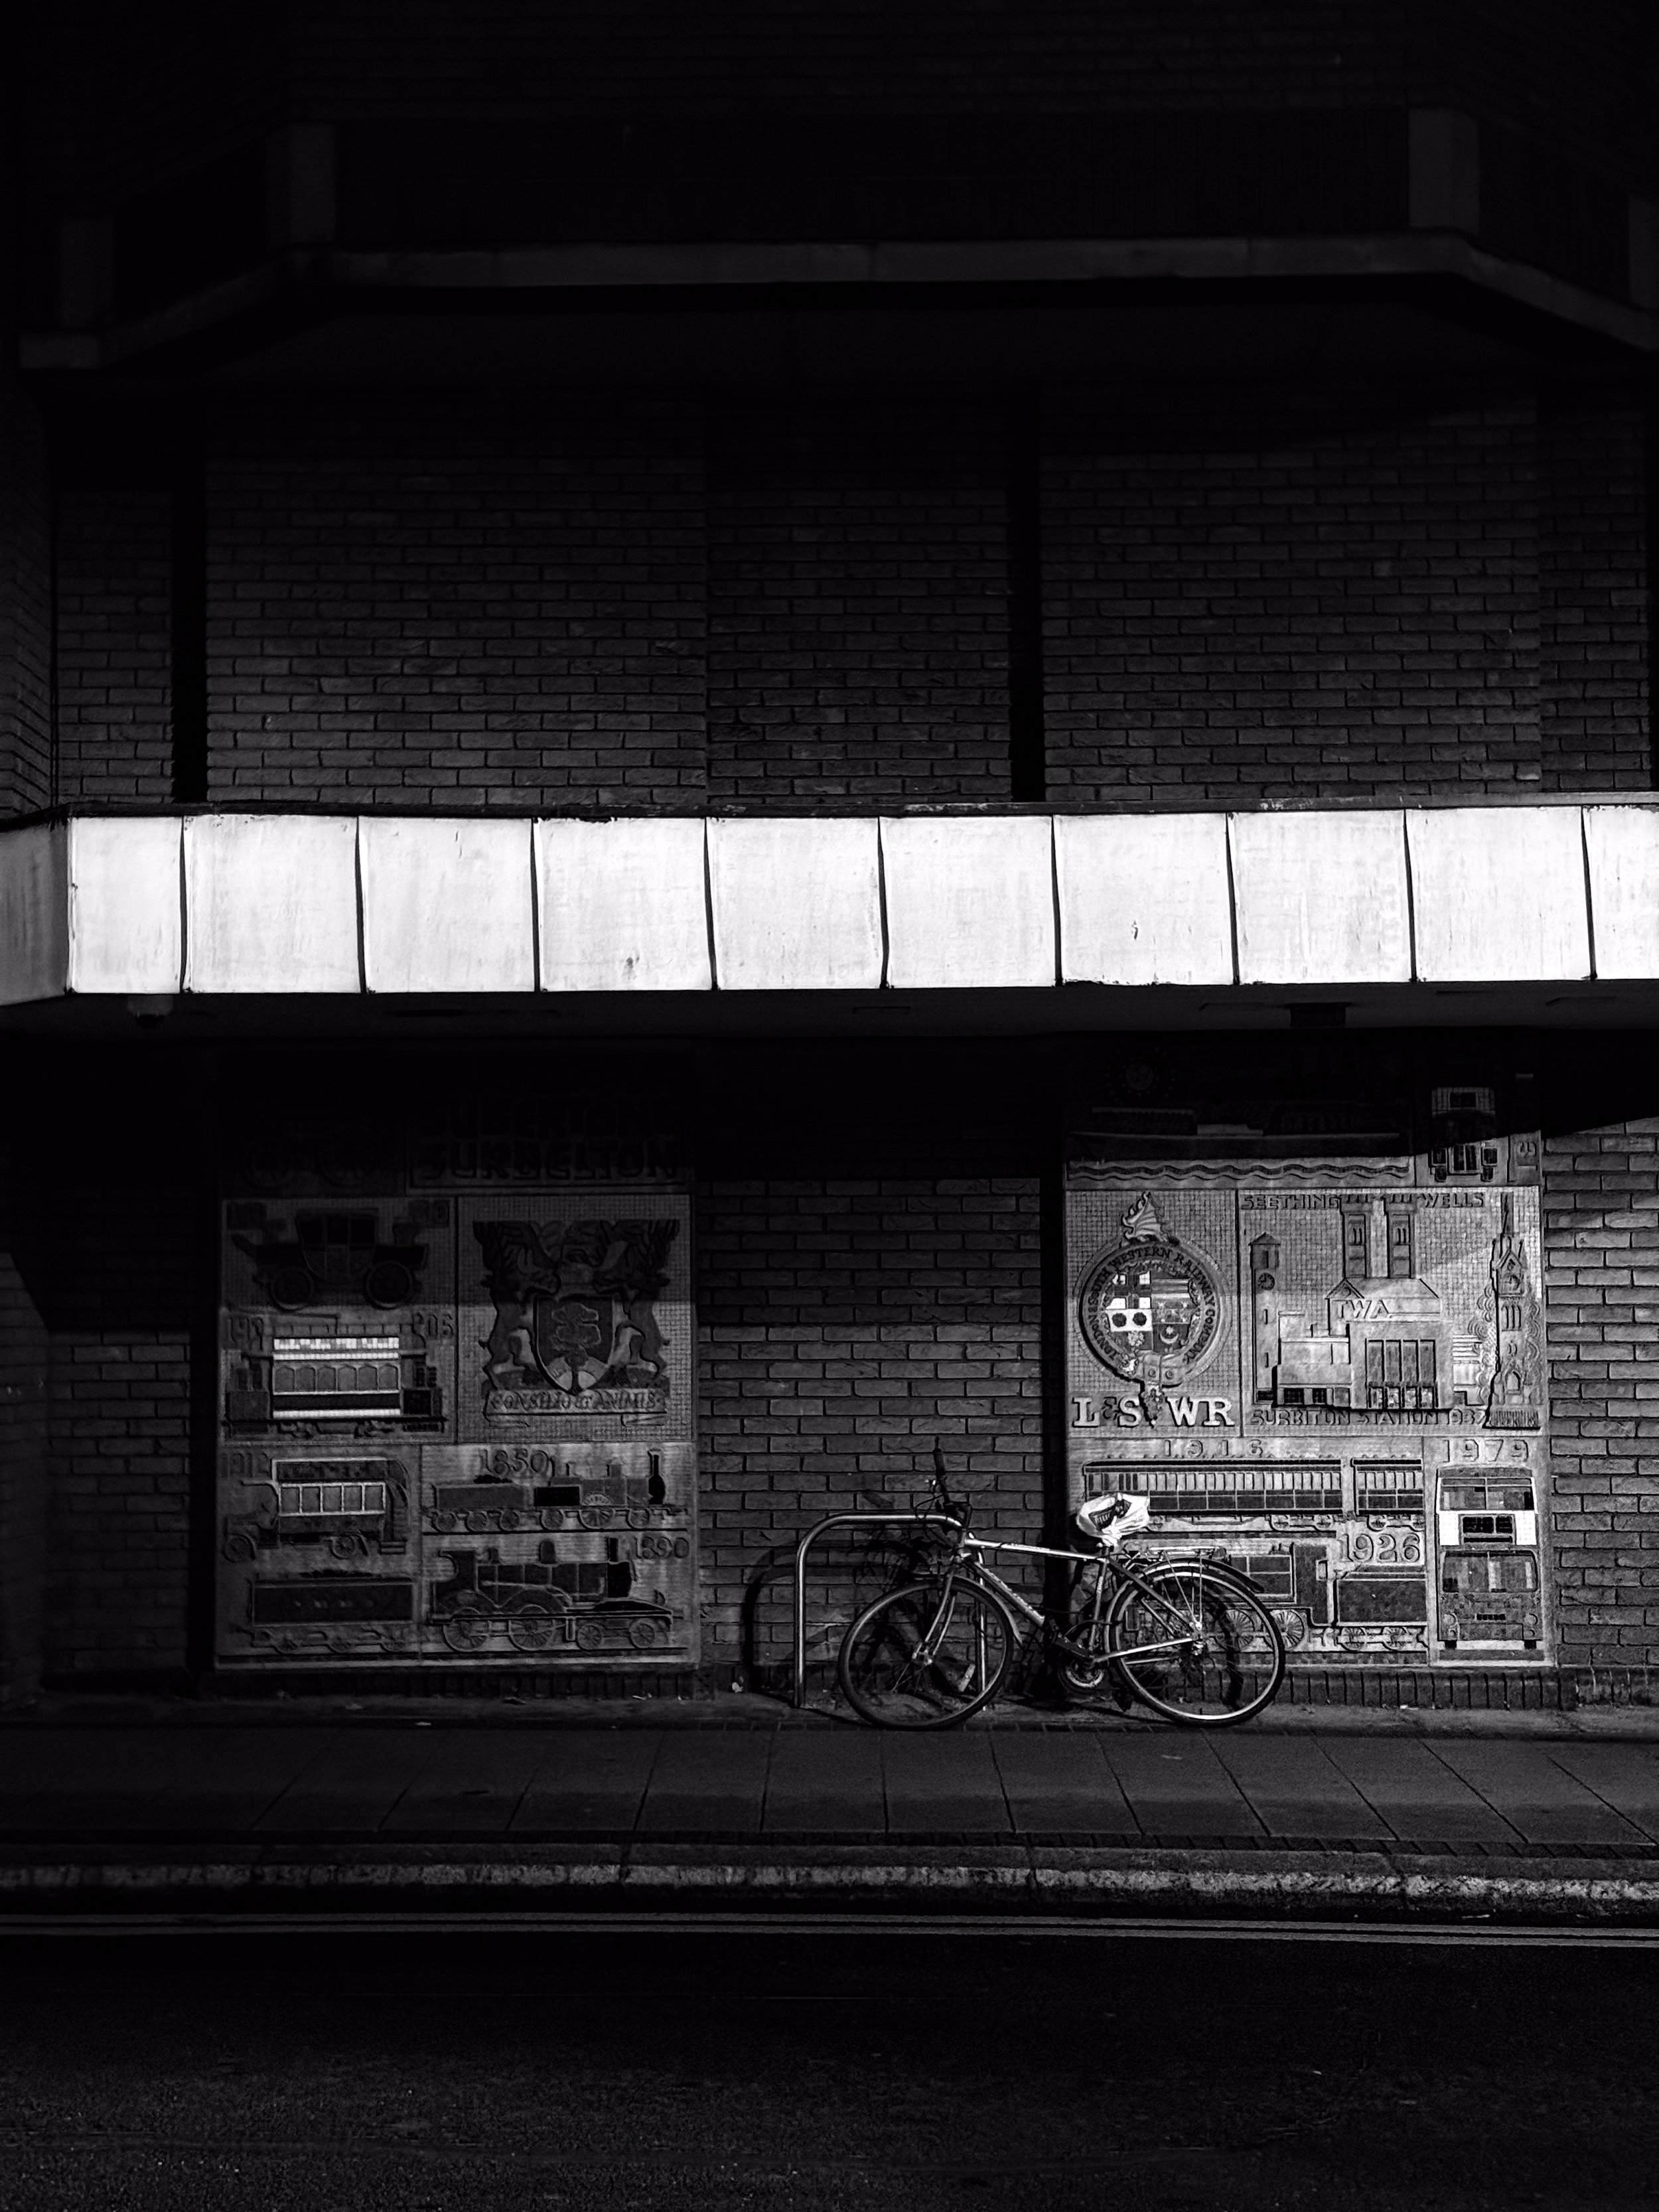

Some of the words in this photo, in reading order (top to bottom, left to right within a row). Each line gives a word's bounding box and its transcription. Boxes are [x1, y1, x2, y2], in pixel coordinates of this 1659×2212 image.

[1241, 1195, 1339, 1210] SEETHING
[1421, 1193, 1484, 1209] WELLS
[1108, 1246, 1172, 1271] WESTERN
[1089, 1266, 1112, 1305] SOUTH
[1173, 1252, 1216, 1307] RAILWAY
[1183, 1308, 1216, 1364] COMPANY
[1252, 1409, 1351, 1426] SURBITON
[1357, 1411, 1439, 1425] STATION
[480, 1448, 549, 1477] 1850
[1443, 1439, 1530, 1463] 1979
[634, 1536, 689, 1560] 1890
[1338, 1532, 1420, 1563] 1926
